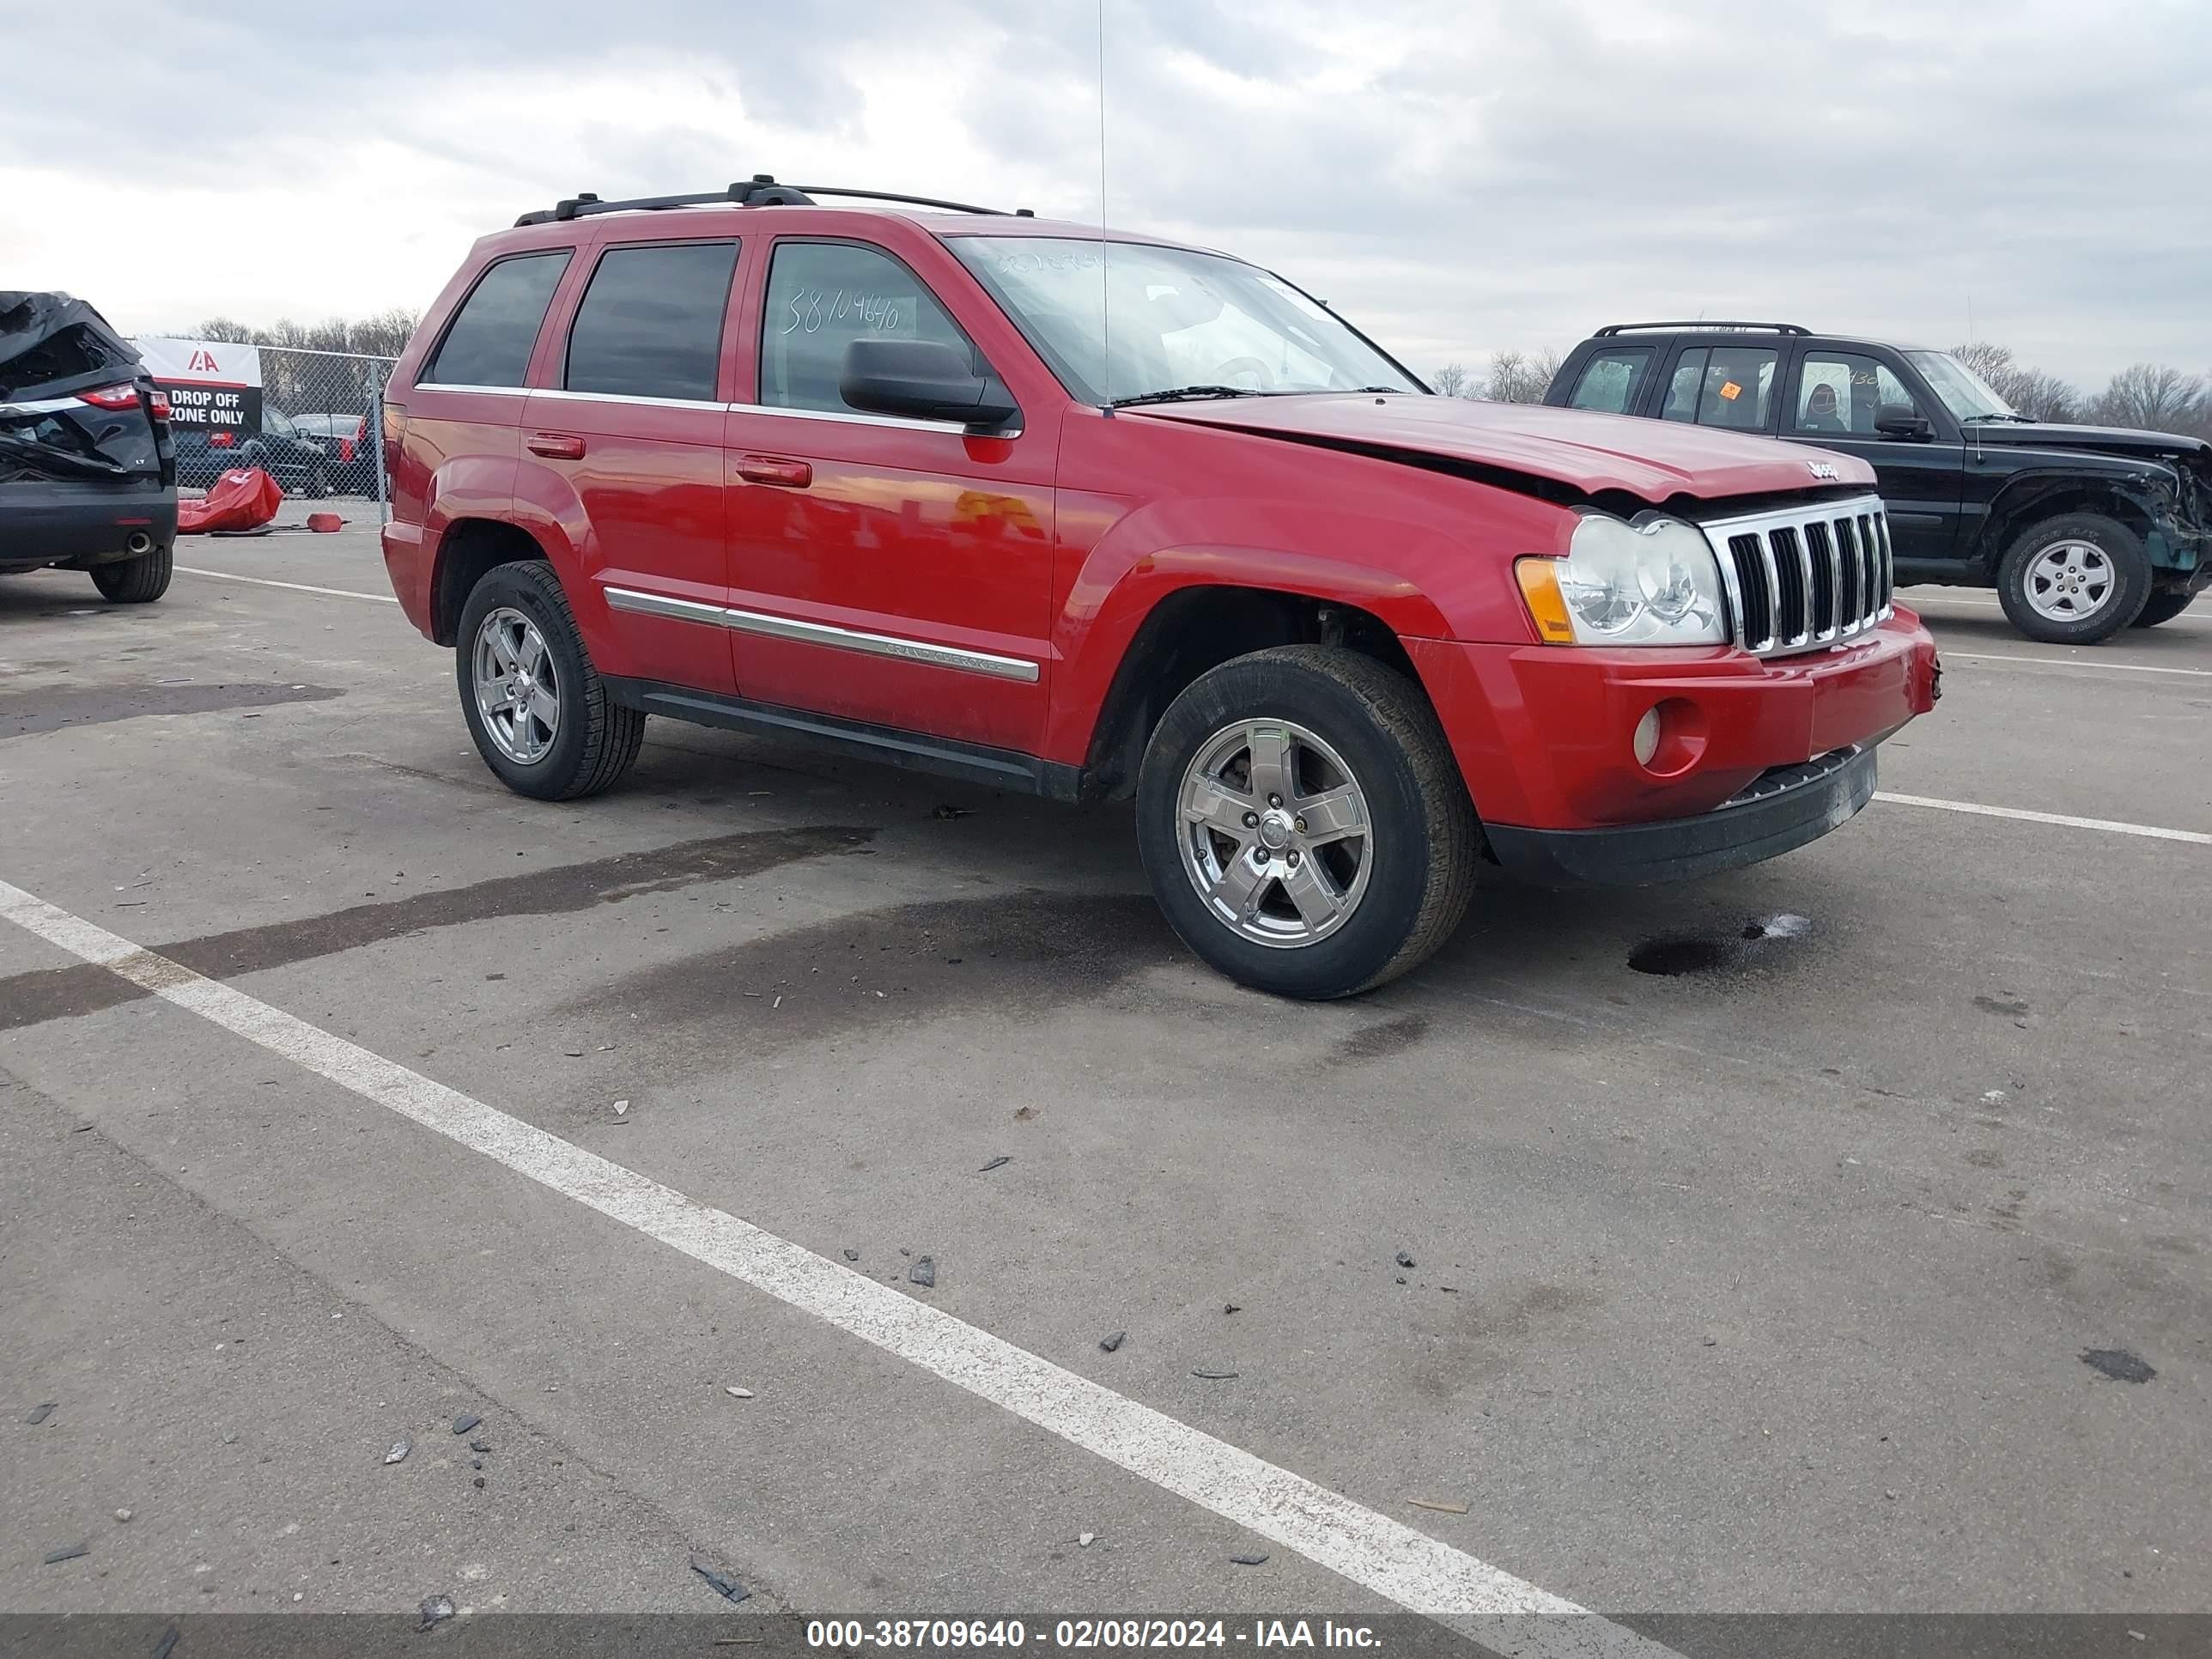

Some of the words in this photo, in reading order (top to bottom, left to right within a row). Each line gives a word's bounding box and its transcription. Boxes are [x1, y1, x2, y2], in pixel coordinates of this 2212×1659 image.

[172, 390, 212, 406] DROP
[216, 393, 240, 408] OFF
[169, 407, 207, 422] ZONE
[210, 410, 245, 425] ONLY
[1807, 460, 1839, 482] Jeep
[885, 644, 929, 658] GRAND
[934, 652, 1004, 672] CHEROKEE
